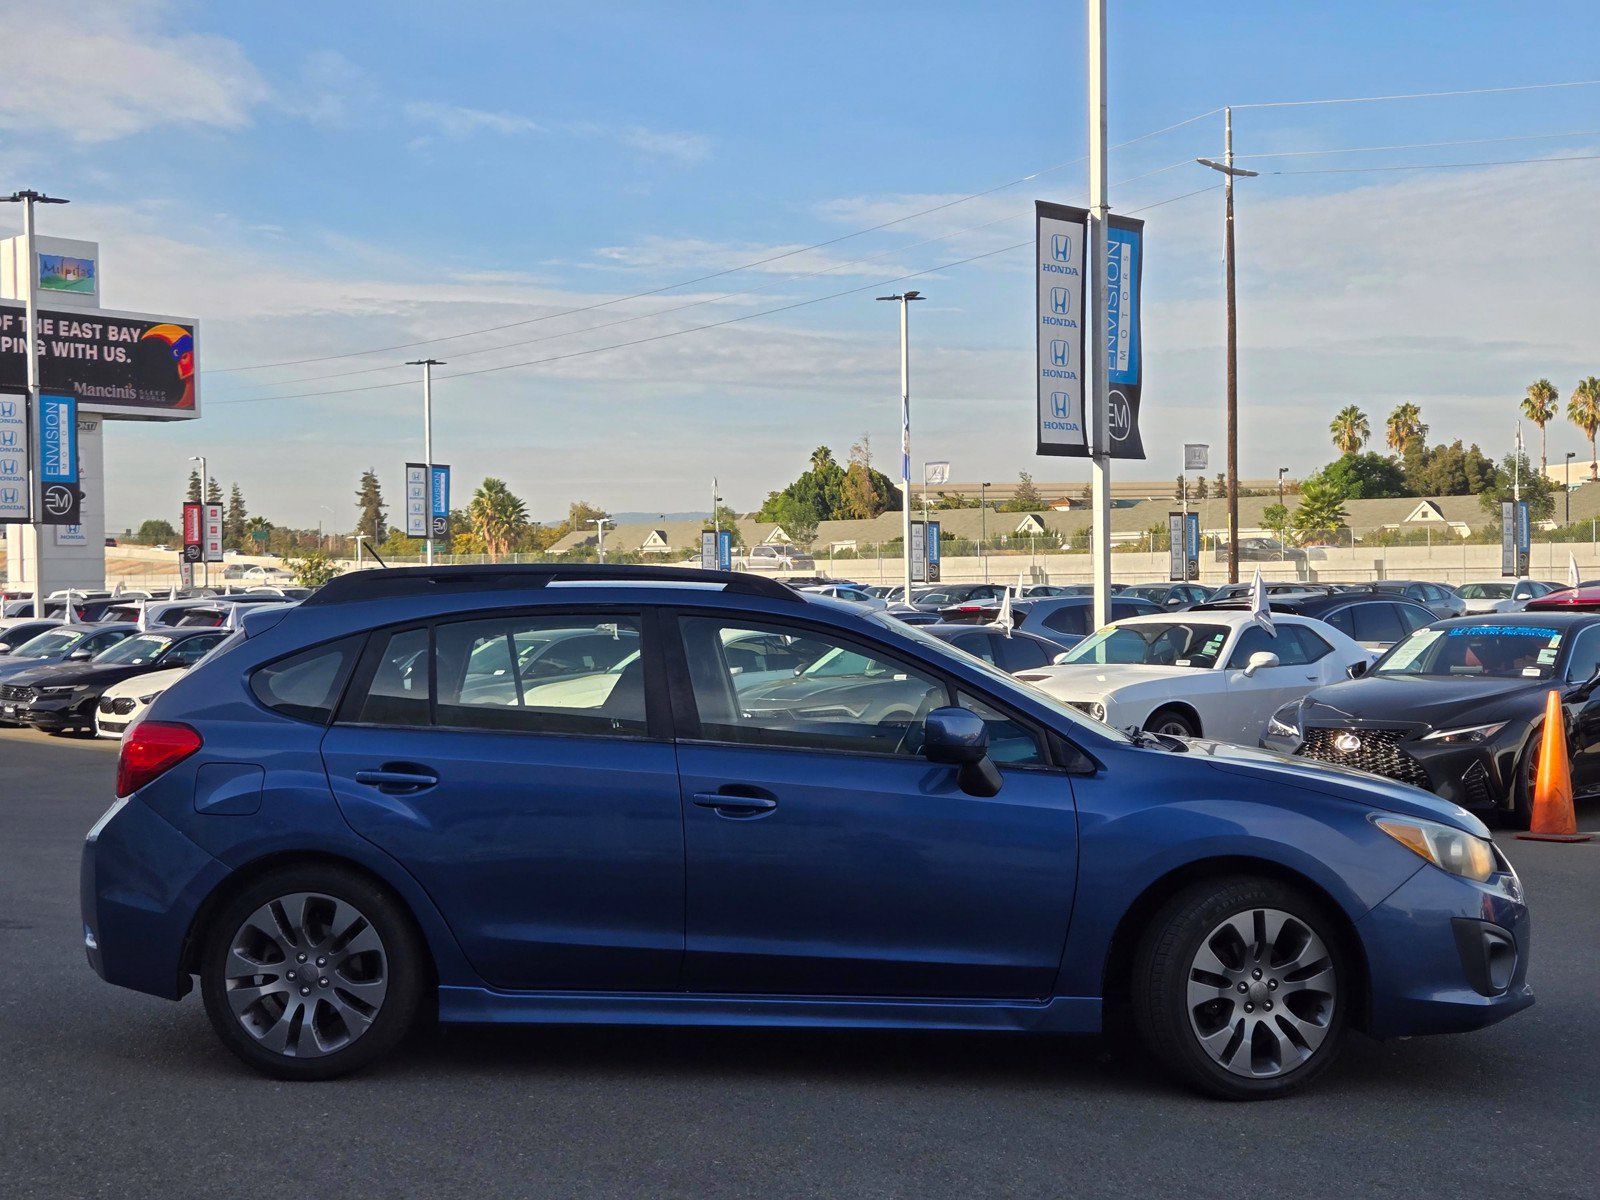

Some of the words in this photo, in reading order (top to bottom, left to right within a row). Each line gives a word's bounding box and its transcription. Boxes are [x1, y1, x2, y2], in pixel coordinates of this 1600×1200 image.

[1042, 263, 1079, 276] HONDA
[1108, 240, 1120, 370] ENVISION
[1120, 255, 1129, 361] MOTORS
[0, 314, 13, 331] F
[59, 320, 103, 340] EAST
[108, 325, 141, 343] BAY
[1042, 316, 1078, 328] HONDA
[52, 341, 98, 360] WITH
[103, 345, 131, 363] US.
[1042, 368, 1078, 380] HONDA
[1043, 420, 1080, 432] HONDA
[46, 402, 59, 475] ENVISION
